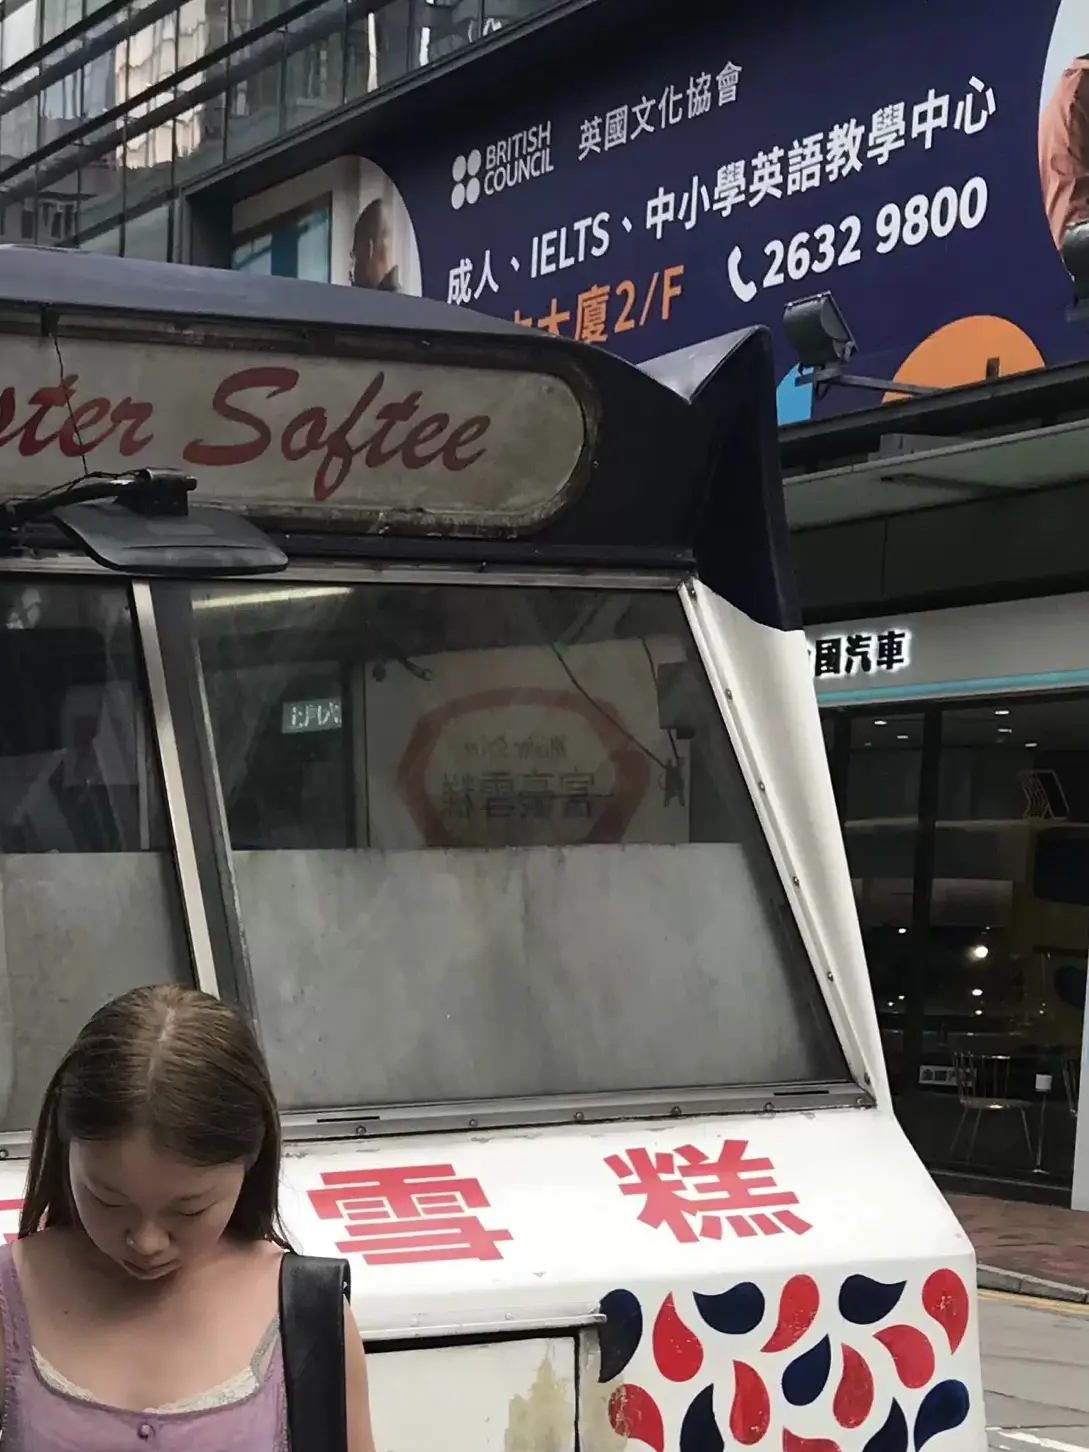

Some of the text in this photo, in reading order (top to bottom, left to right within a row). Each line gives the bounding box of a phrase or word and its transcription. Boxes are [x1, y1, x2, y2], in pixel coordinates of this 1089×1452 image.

[485, 121, 552, 166] BRITISH
[577, 61, 743, 162] 英國文化協會
[484, 148, 555, 196] COUNCIL
[762, 175, 989, 290] 2632 9800
[183, 366, 492, 502] Softee
